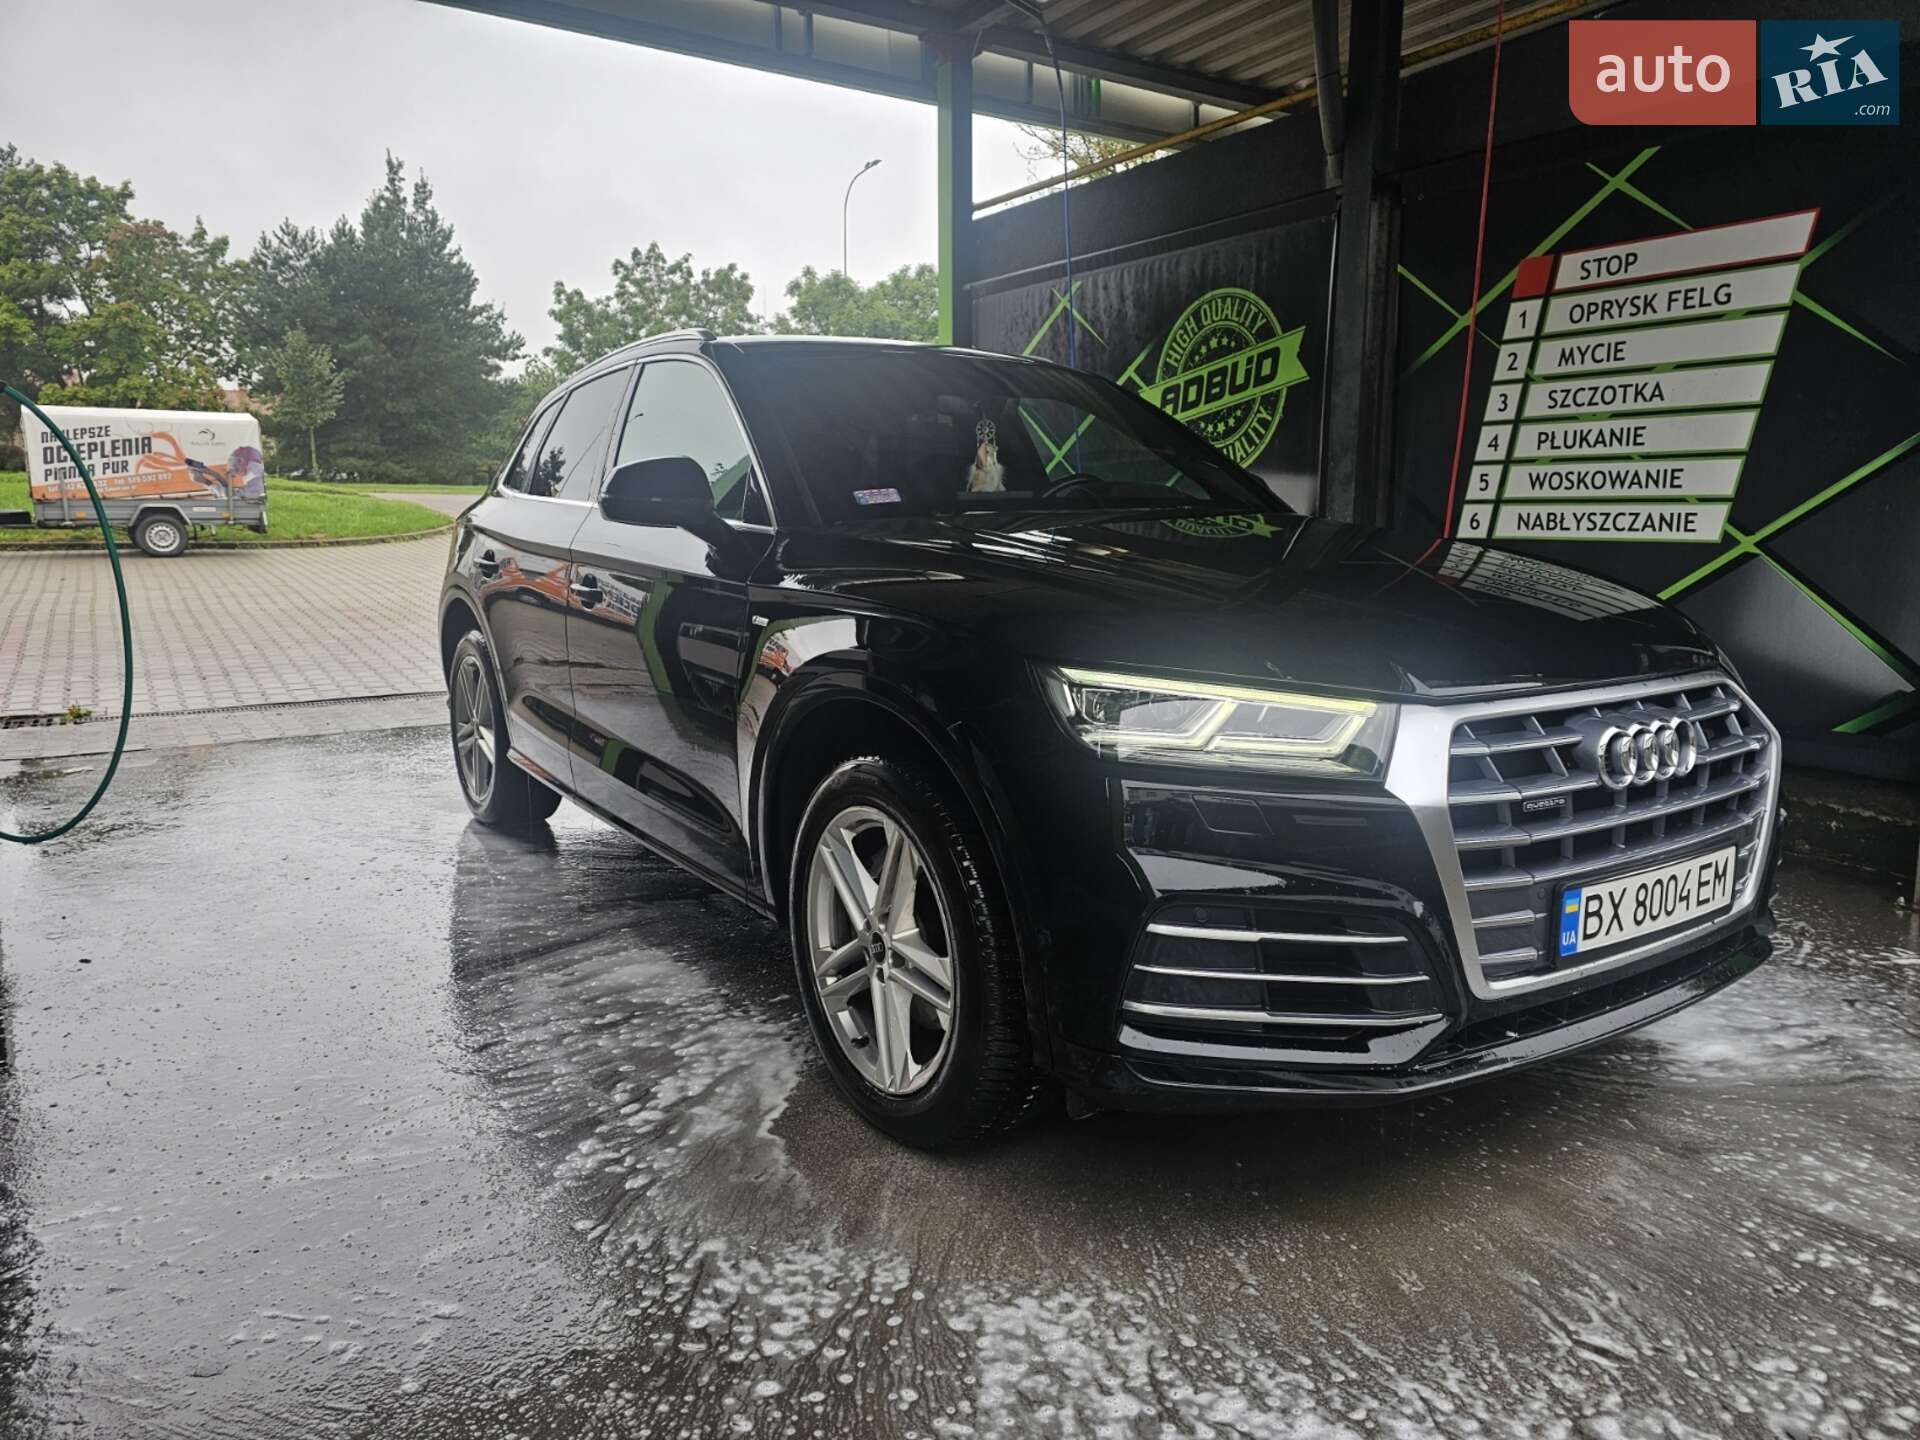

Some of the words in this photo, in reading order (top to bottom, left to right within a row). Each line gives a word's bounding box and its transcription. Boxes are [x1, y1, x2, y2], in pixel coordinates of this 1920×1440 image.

[1579, 252, 1638, 280] STOP
[1568, 294, 1658, 324] OPRYSK
[1666, 283, 1732, 313] FELG
[1518, 310, 1528, 330] 1
[1166, 316, 1198, 367] HIGH
[1200, 297, 1267, 334] QUALITY
[1507, 352, 1518, 372] 2
[1557, 341, 1627, 368] MYCIE
[1161, 347, 1280, 417] ADBUD
[1497, 393, 1509, 413] 3
[1546, 382, 1666, 409] SZCZOTKA
[41, 425, 111, 443] NALEPSZE
[1487, 434, 1499, 453] 4
[1536, 426, 1647, 450] PŁUKANIE
[43, 436, 152, 465] OCEPLENIA
[44, 463, 95, 482] PIANA
[102, 460, 129, 475] PUR
[1528, 468, 1684, 490] WOSKOWANIE
[1478, 473, 1490, 492] 5
[1469, 514, 1481, 530] 6
[1516, 512, 1698, 533] NABŁYSZCZANIE
[1582, 887, 1627, 941] BX
[1633, 869, 1692, 927] 8004
[1697, 856, 1729, 908] EM
[1562, 931, 1576, 946] UA
